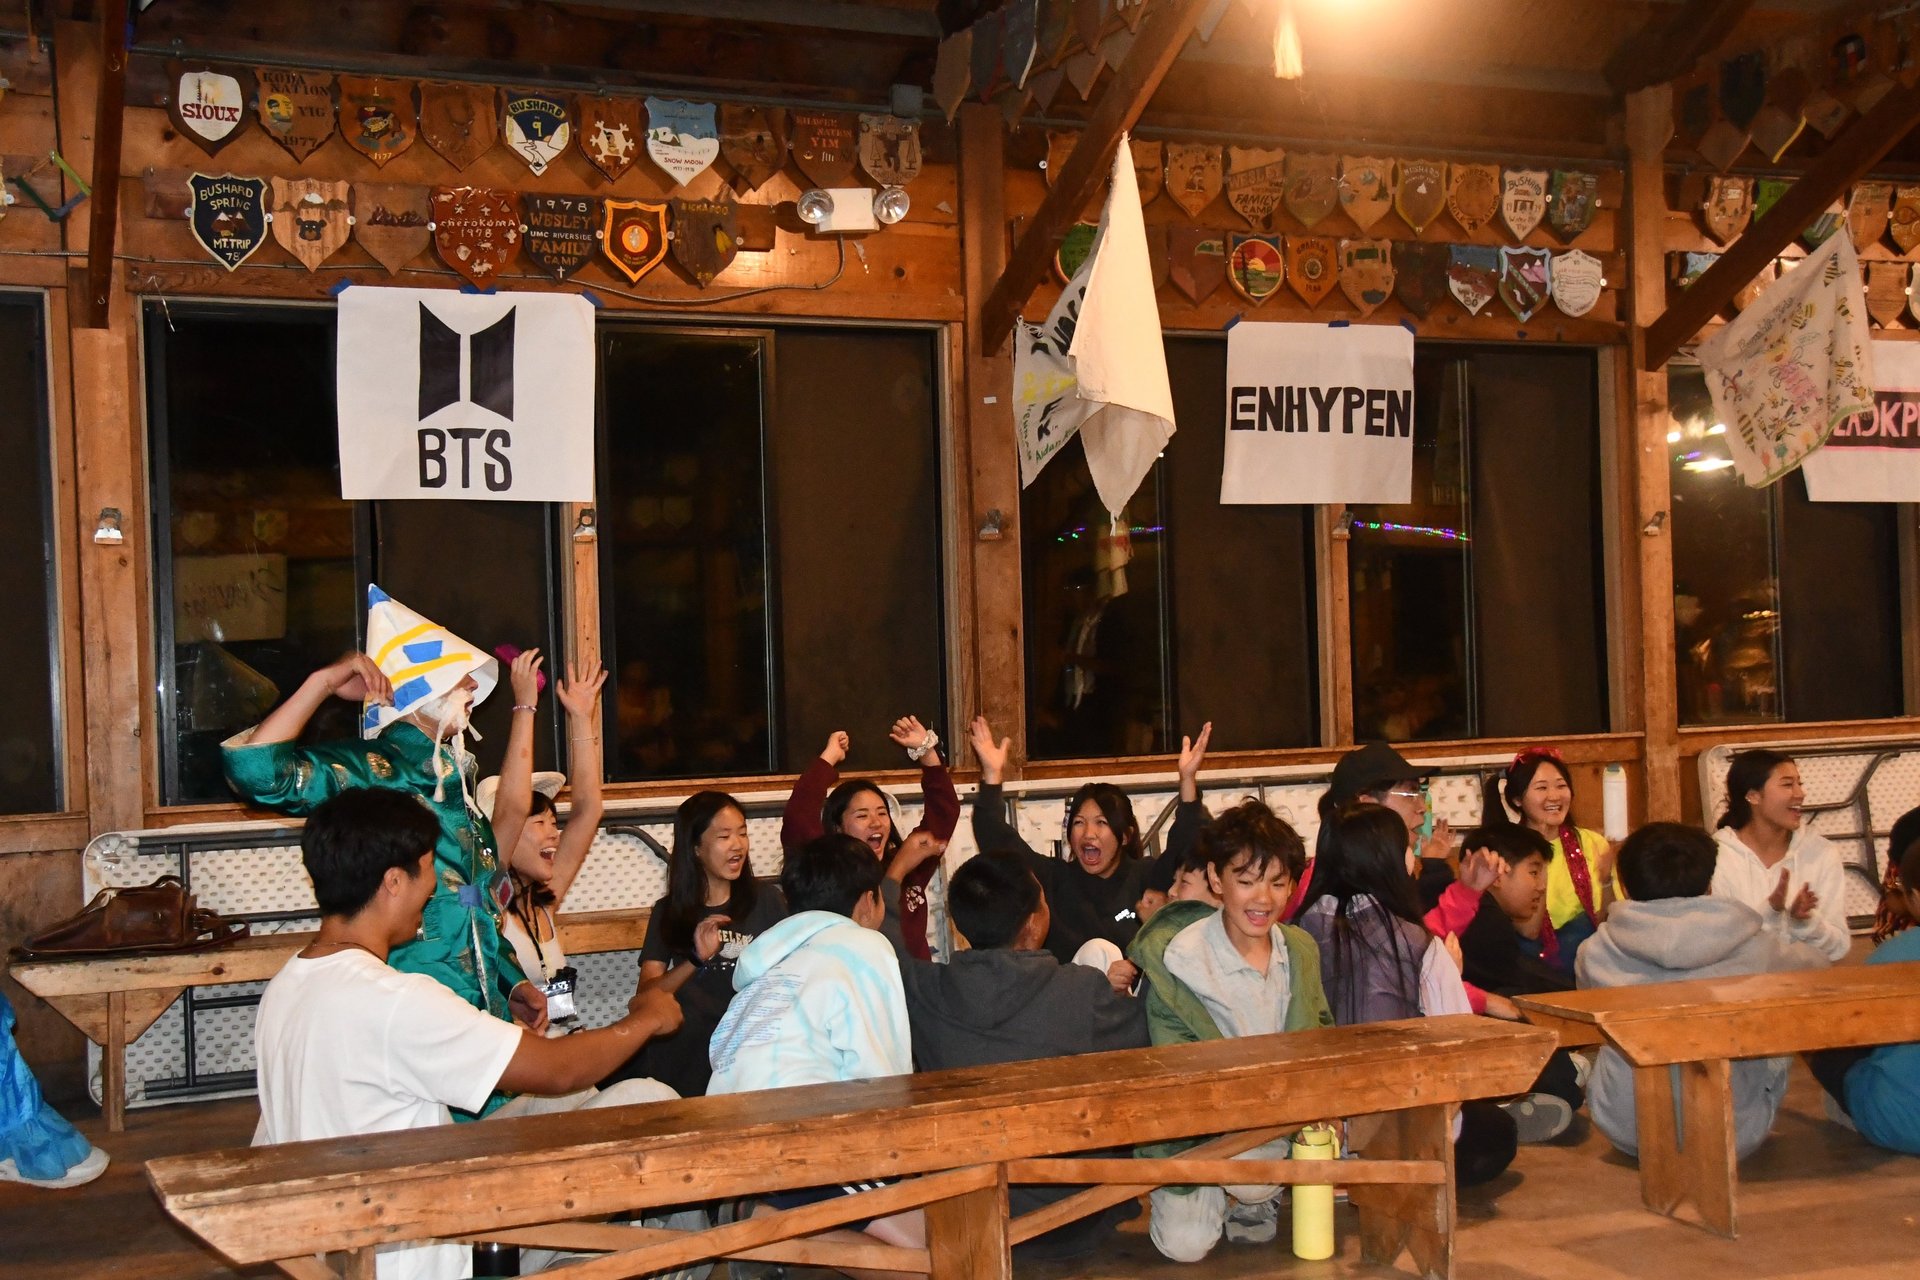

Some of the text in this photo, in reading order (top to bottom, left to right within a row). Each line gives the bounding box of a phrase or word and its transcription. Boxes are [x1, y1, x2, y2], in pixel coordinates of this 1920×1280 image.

[273, 84, 329, 97] NATION
[181, 102, 241, 123] SIOUX
[510, 101, 565, 118] BUSHARD
[531, 121, 543, 138] 9
[281, 135, 318, 148] 1977
[810, 136, 840, 149] YIM
[663, 156, 683, 165] SNOW
[201, 183, 254, 201] BUSHARD
[210, 197, 251, 211] SPRING
[536, 199, 589, 213] 1978
[1234, 193, 1280, 207] FAMILY
[1241, 205, 1273, 215] CAMP
[529, 212, 593, 230] WESLEY
[460, 229, 493, 239] 1978
[530, 230, 593, 241] UMC RIVERSIDE
[531, 240, 593, 256] FAMILY
[543, 255, 579, 267] CAMP
[1230, 386, 1412, 438] ENHYPEN
[418, 428, 513, 492] BTS
